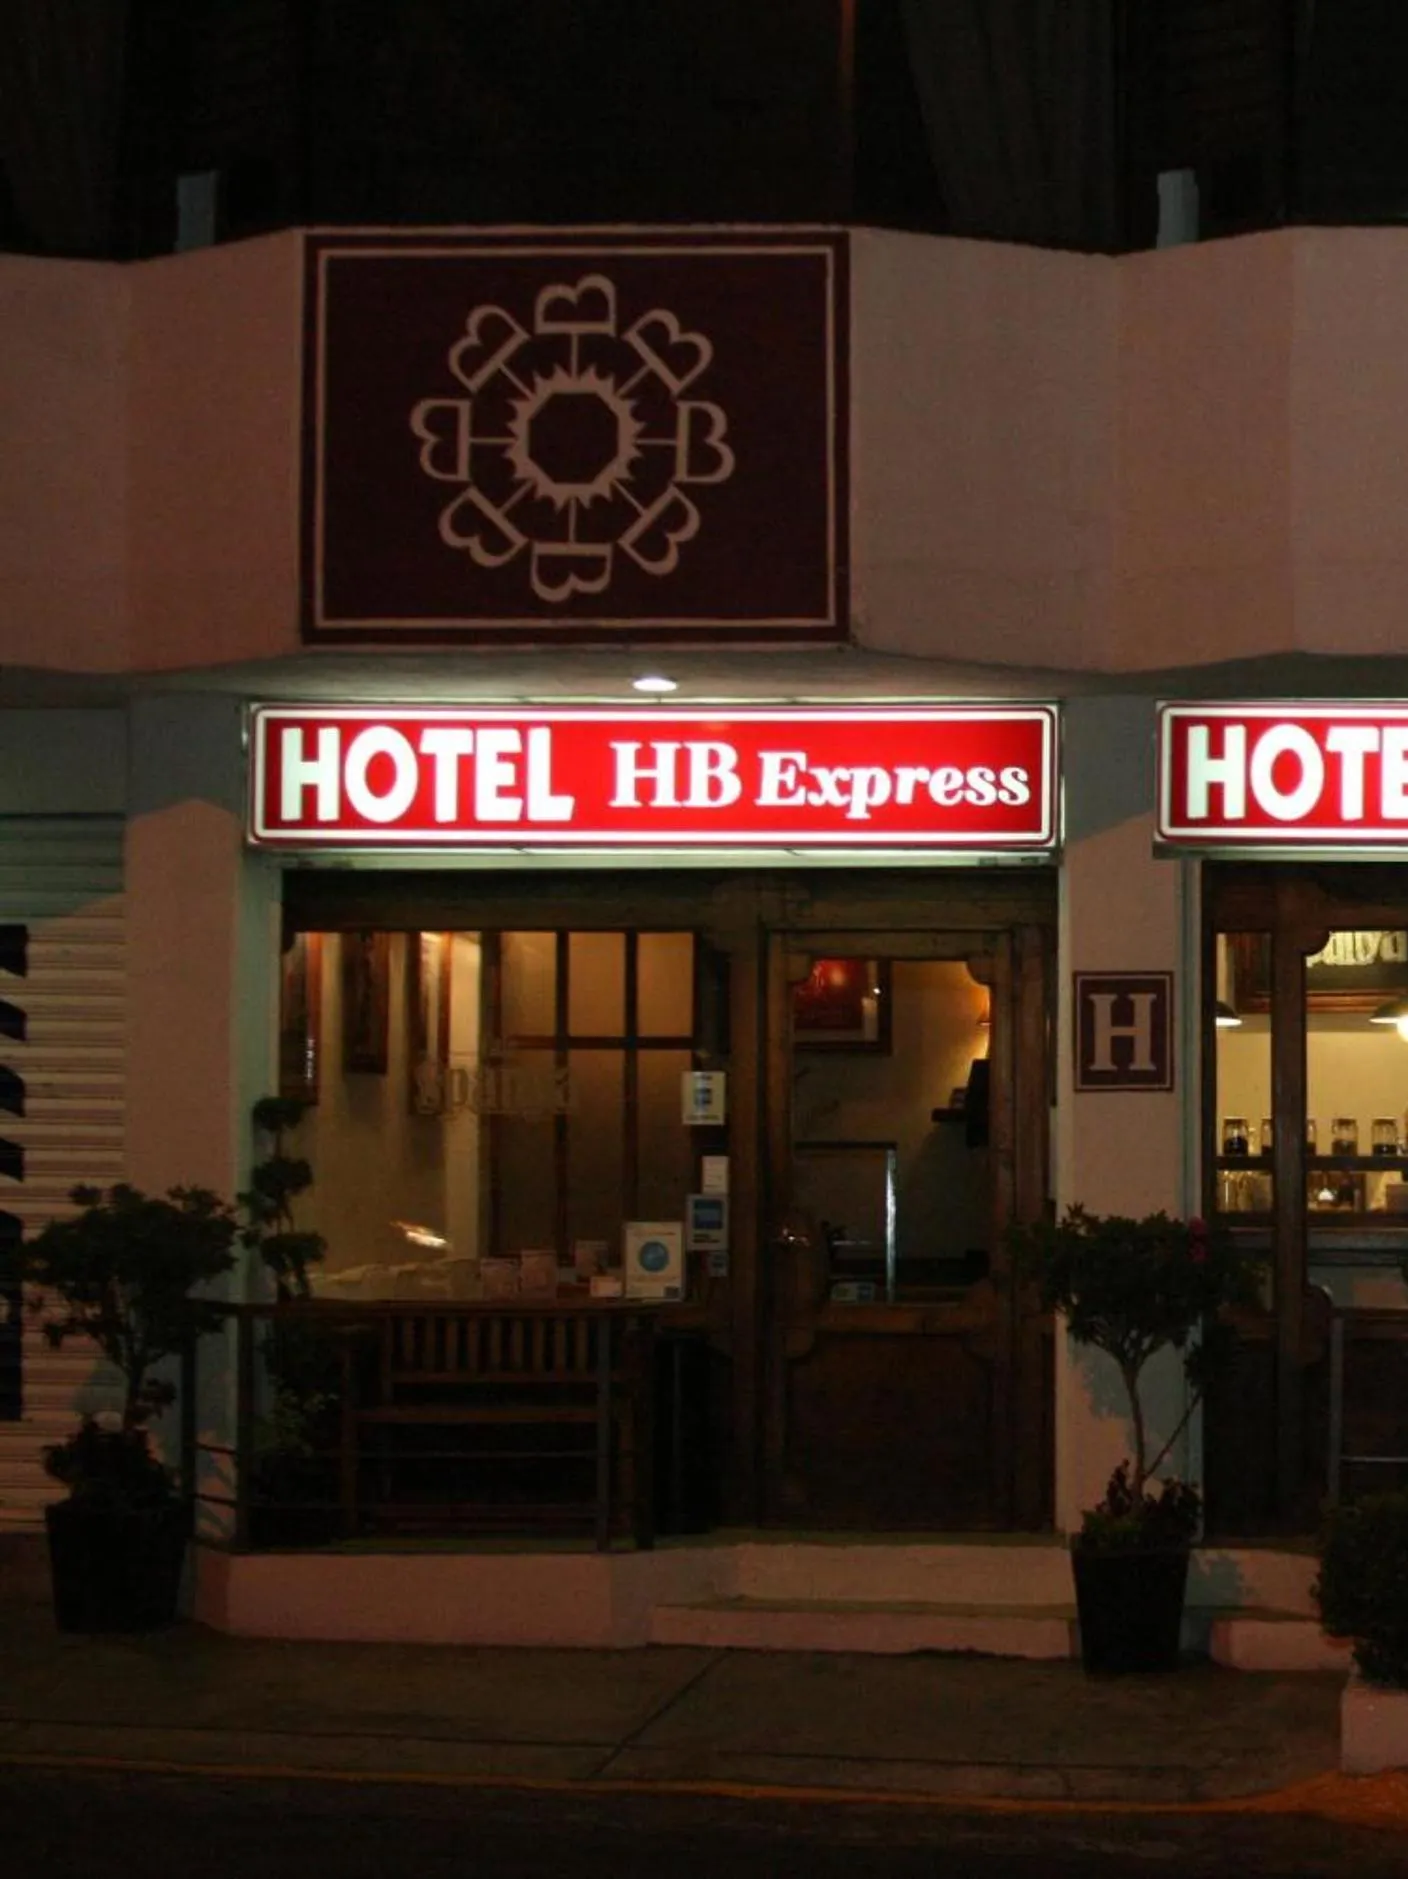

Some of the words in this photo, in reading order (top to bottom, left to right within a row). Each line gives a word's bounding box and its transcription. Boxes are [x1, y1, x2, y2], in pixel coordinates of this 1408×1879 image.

[281, 725, 574, 823] HOTEL
[609, 741, 742, 808] HB
[755, 750, 1031, 820] Express
[1088, 993, 1157, 1071] H
